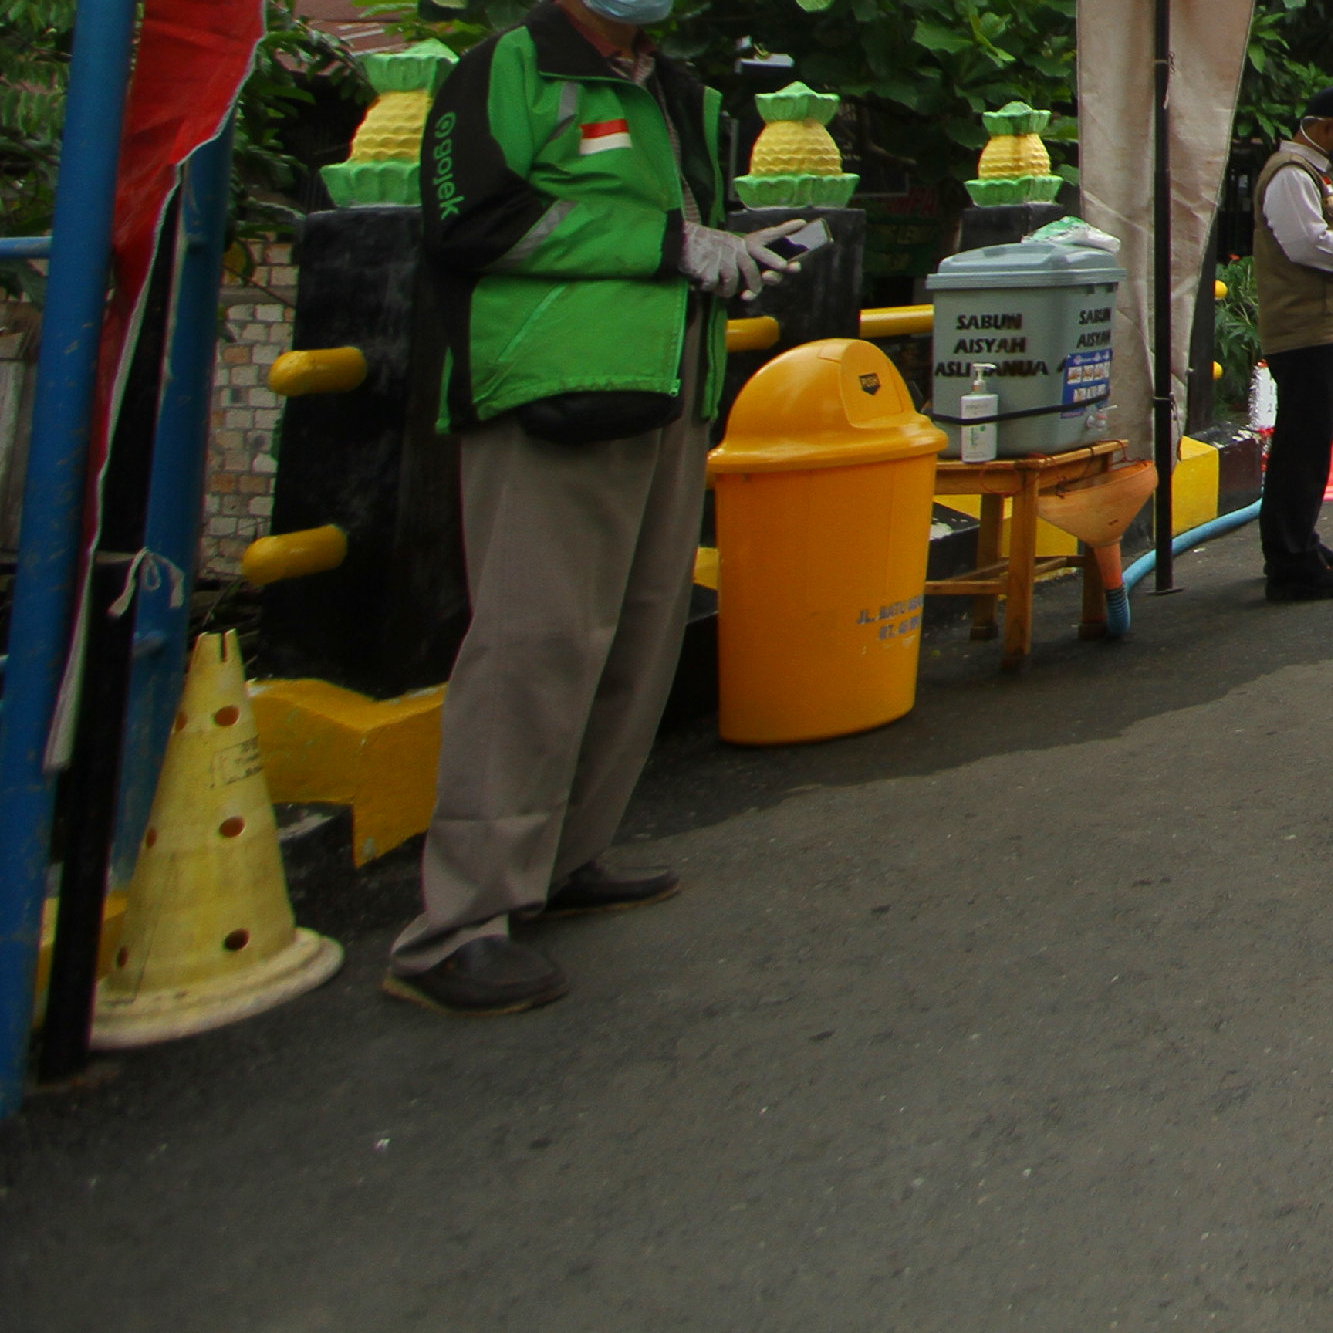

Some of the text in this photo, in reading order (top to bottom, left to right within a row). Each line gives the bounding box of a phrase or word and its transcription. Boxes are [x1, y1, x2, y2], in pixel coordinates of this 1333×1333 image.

[956, 314, 1022, 330] SABUN
[954, 337, 1026, 354] AISYAH
[935, 360, 970, 377] ASLI
